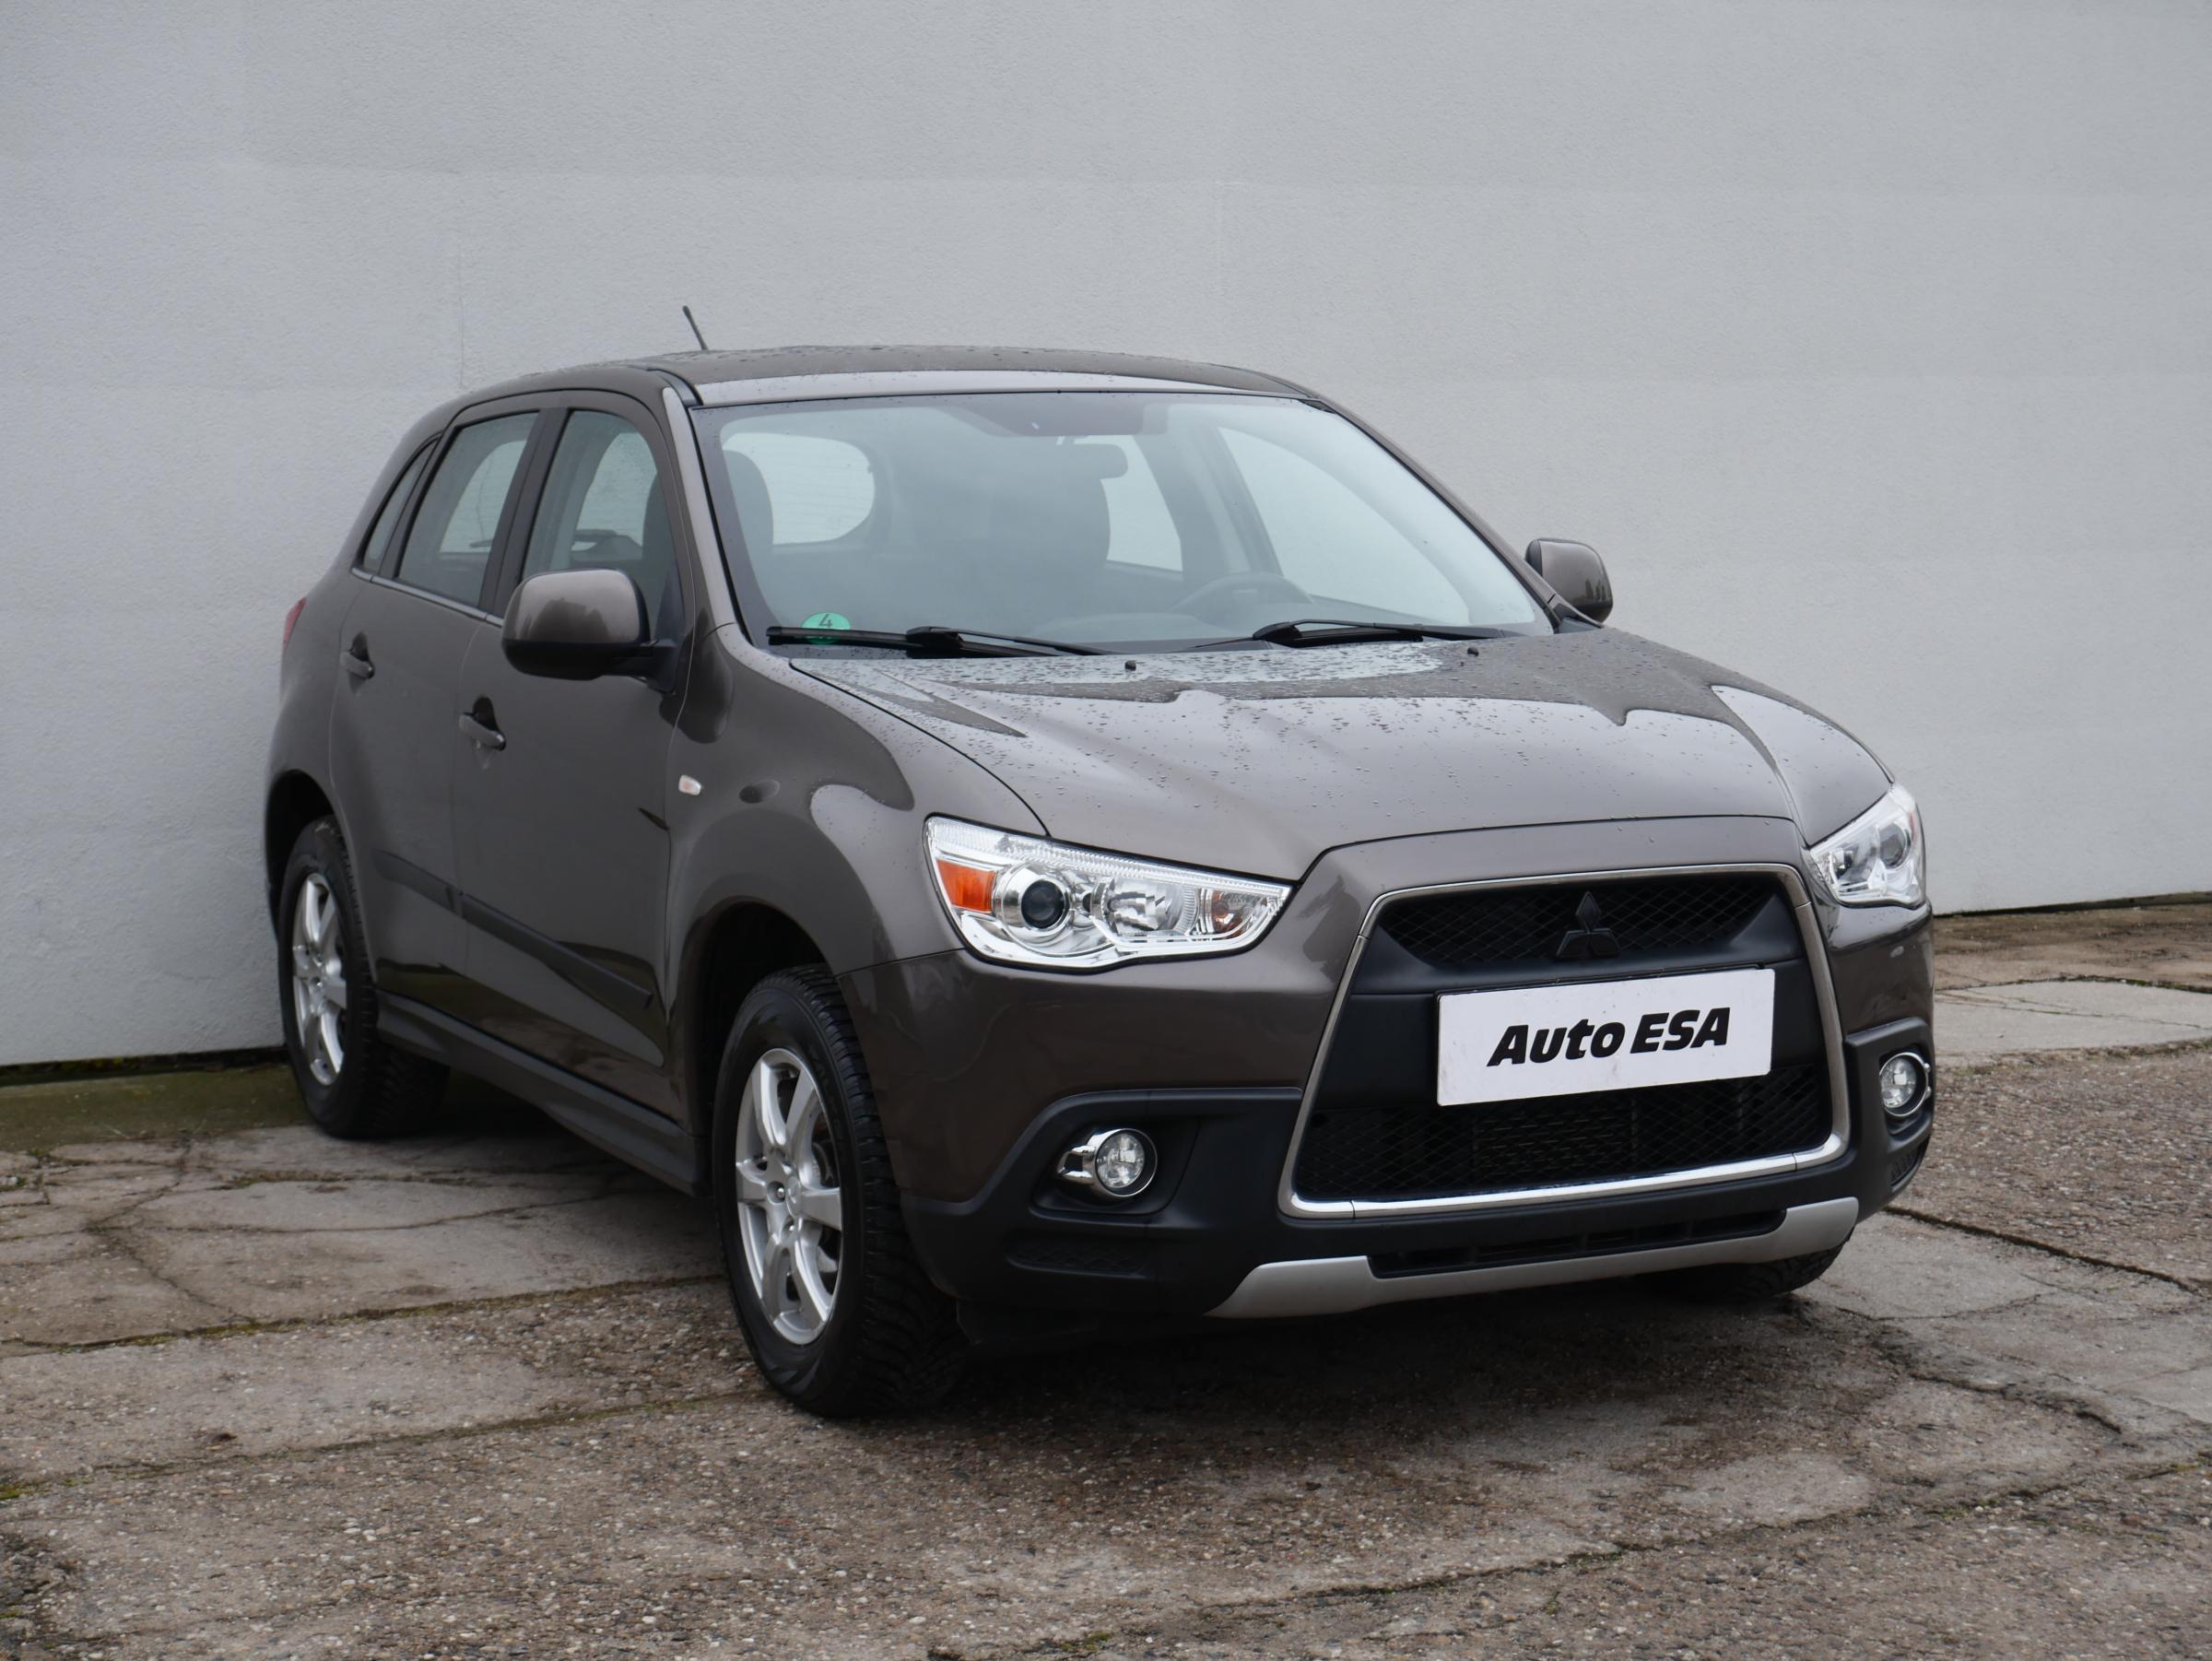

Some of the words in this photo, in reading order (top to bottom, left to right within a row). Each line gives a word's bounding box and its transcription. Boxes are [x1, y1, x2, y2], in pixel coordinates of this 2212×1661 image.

[818, 613, 833, 628] 4
[1486, 1019, 1626, 1067] Auto
[1630, 1007, 1731, 1054] ESA
